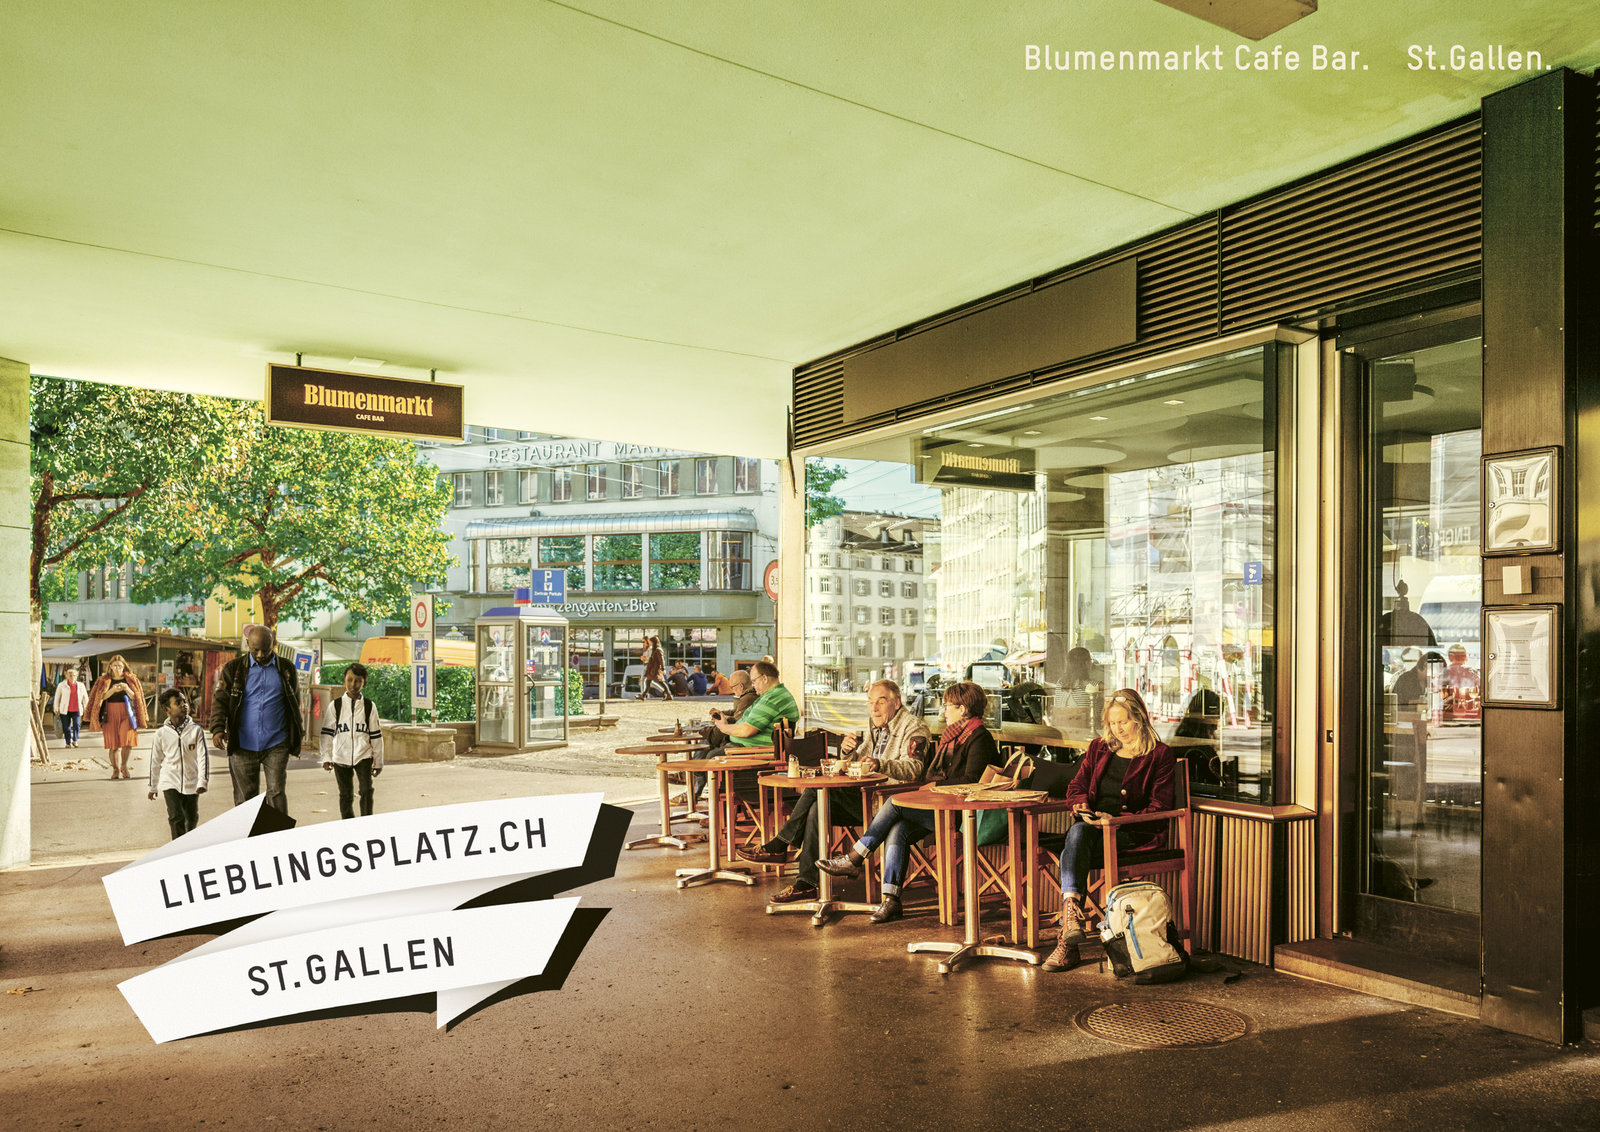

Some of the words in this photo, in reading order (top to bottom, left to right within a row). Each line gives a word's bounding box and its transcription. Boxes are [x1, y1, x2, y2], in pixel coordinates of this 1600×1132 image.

[303, 383, 434, 417] Blumenmarkt
[355, 413, 371, 421] CAFE
[488, 441, 602, 464] RESTAURANT
